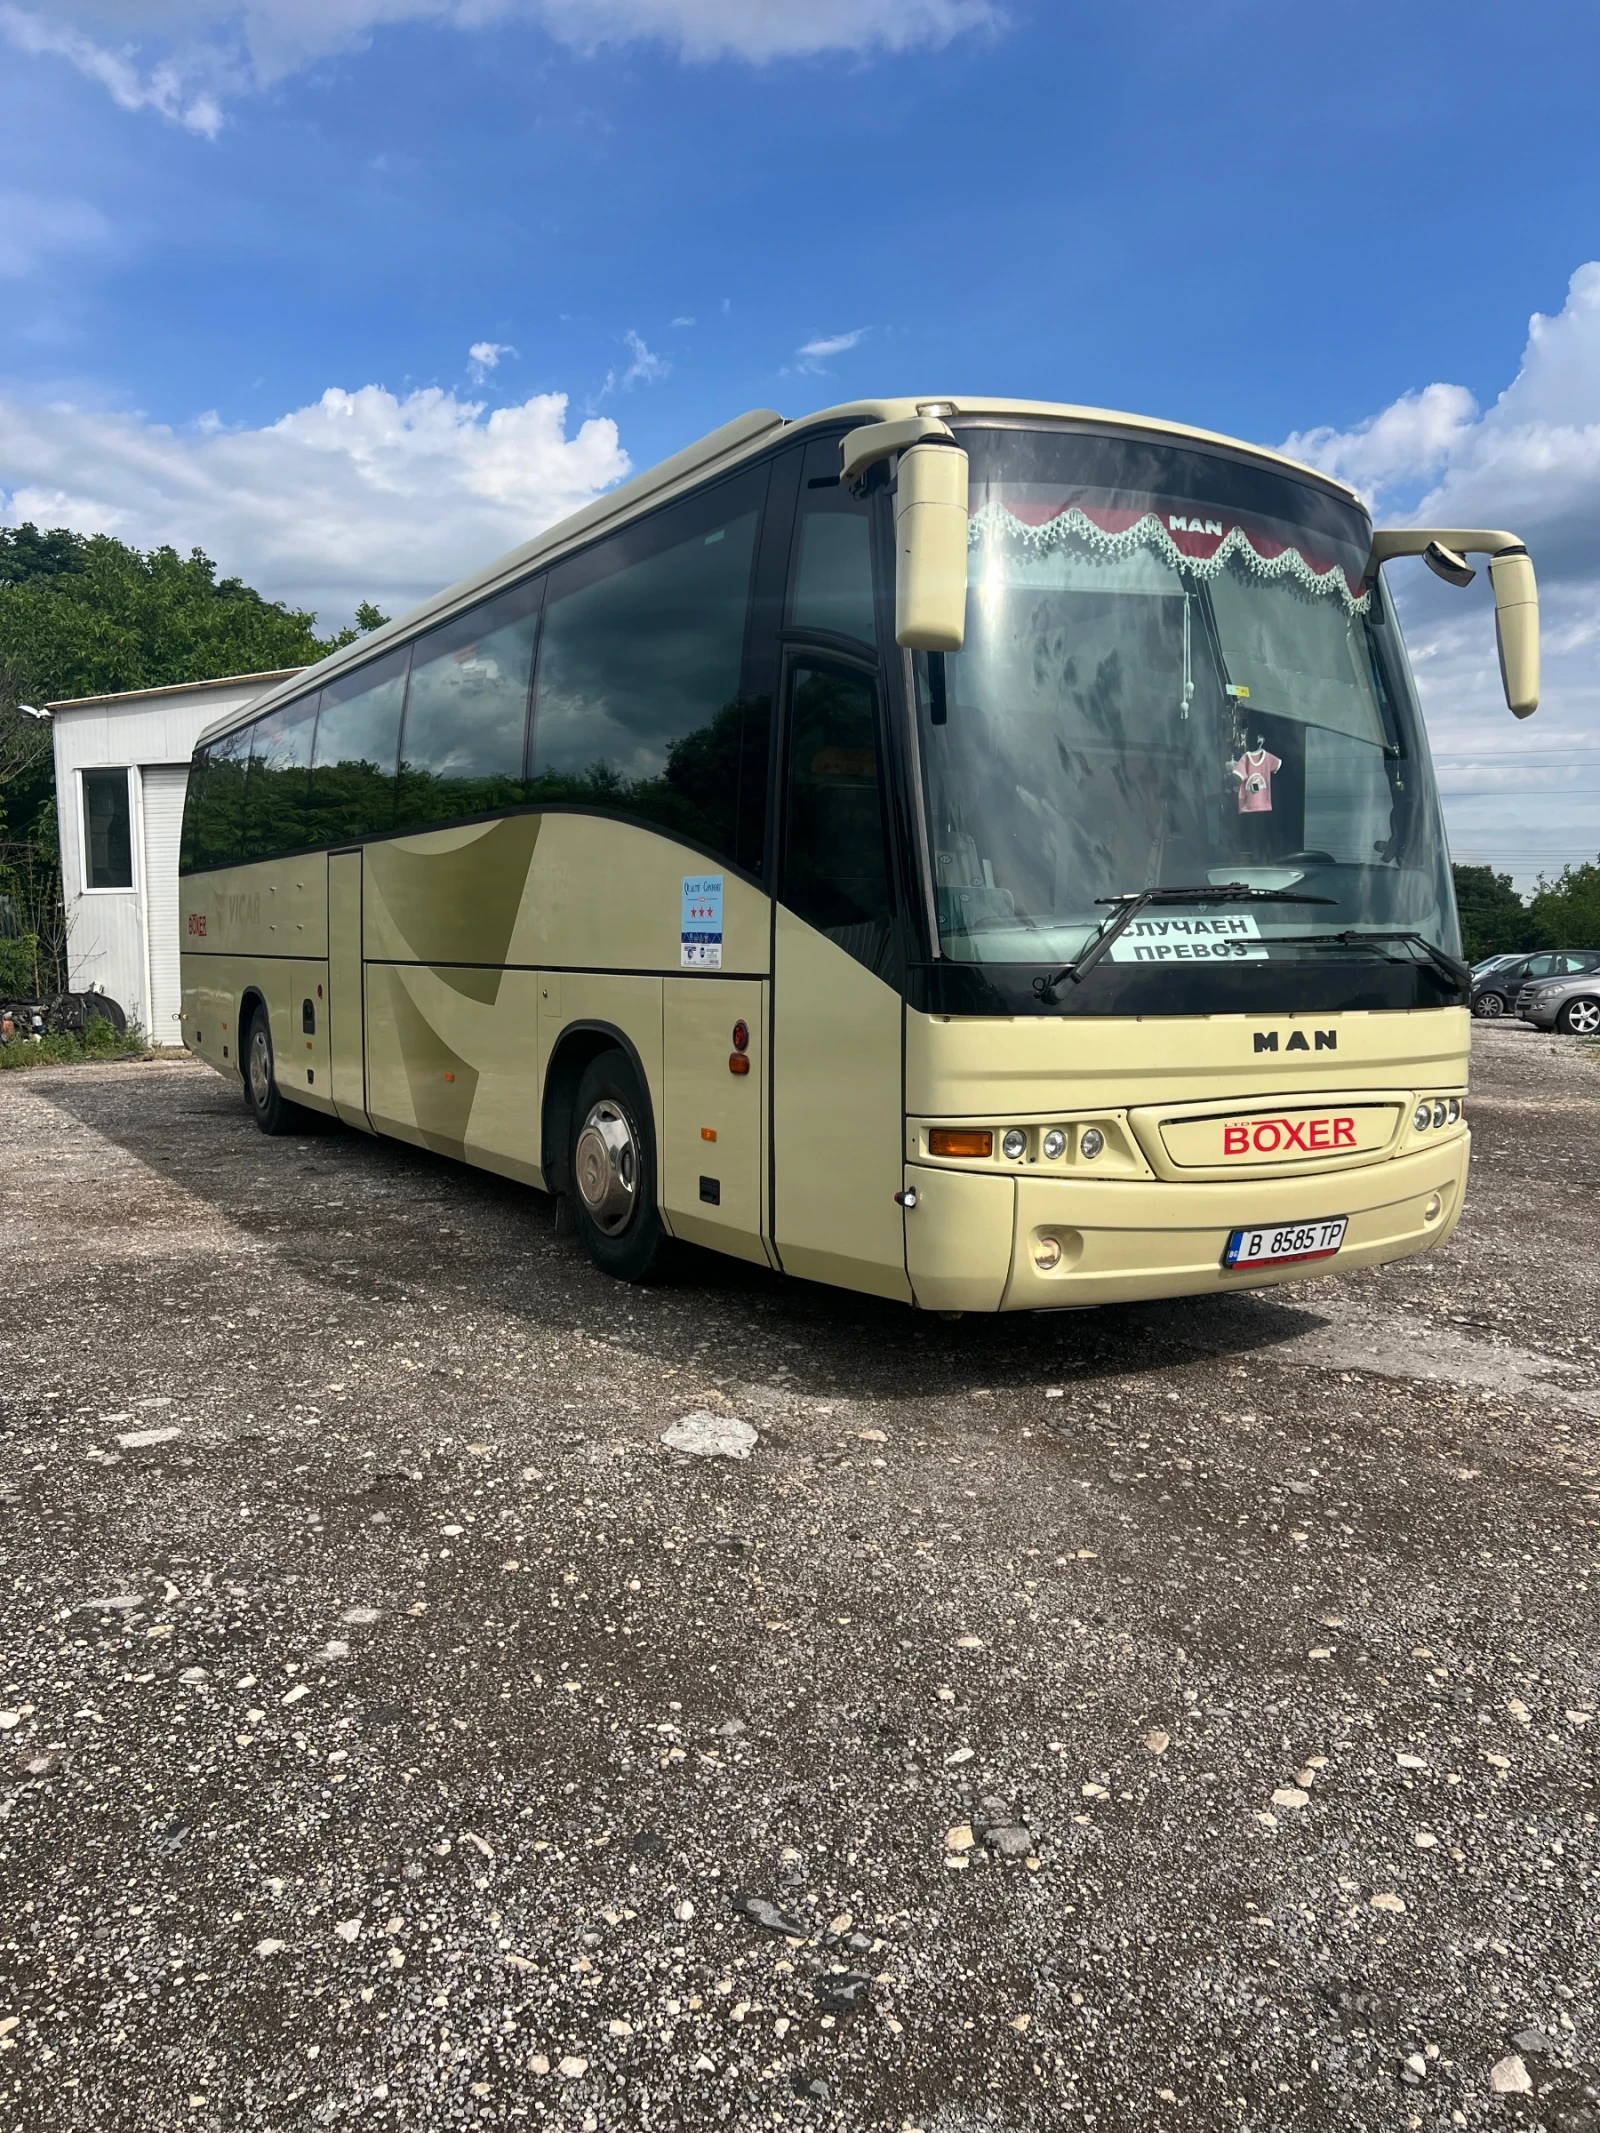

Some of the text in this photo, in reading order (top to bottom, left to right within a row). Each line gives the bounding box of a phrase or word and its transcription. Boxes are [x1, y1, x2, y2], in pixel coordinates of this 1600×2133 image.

[1169, 515, 1223, 537] MAN
[1119, 919, 1249, 938] СЛУЧАЕН
[1133, 943, 1249, 961] ПРЕВОЗ
[1253, 1030, 1338, 1053] MAN
[1223, 1117, 1357, 1156] BOXER
[1271, 1227, 1317, 1254] 8585
[1229, 1250, 1239, 1258] BG
